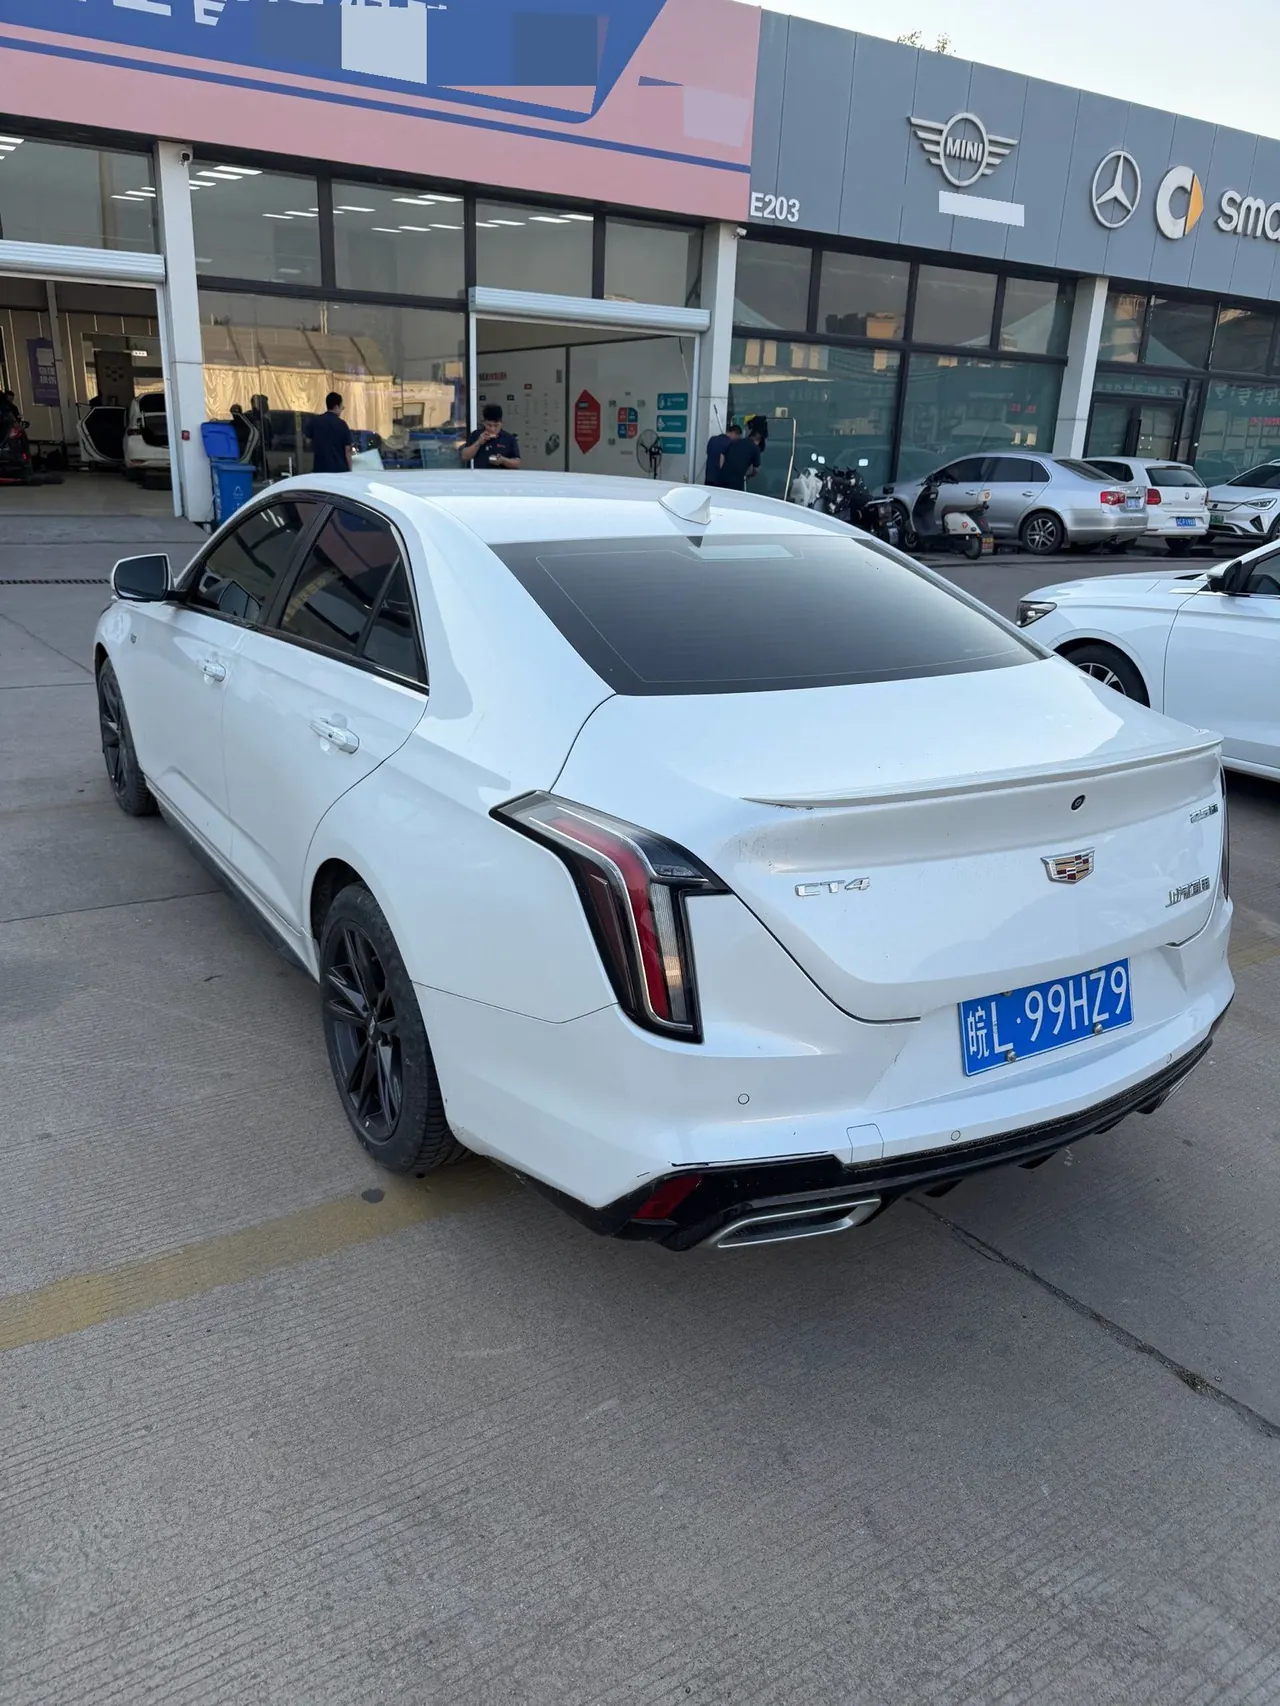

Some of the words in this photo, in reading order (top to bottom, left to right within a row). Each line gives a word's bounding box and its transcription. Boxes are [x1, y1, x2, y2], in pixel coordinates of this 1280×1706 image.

[946, 136, 984, 162] MINI
[751, 191, 800, 222] E203
[795, 877, 870, 897] CT4
[966, 965, 1128, 1060] 皖L·99HZ9
